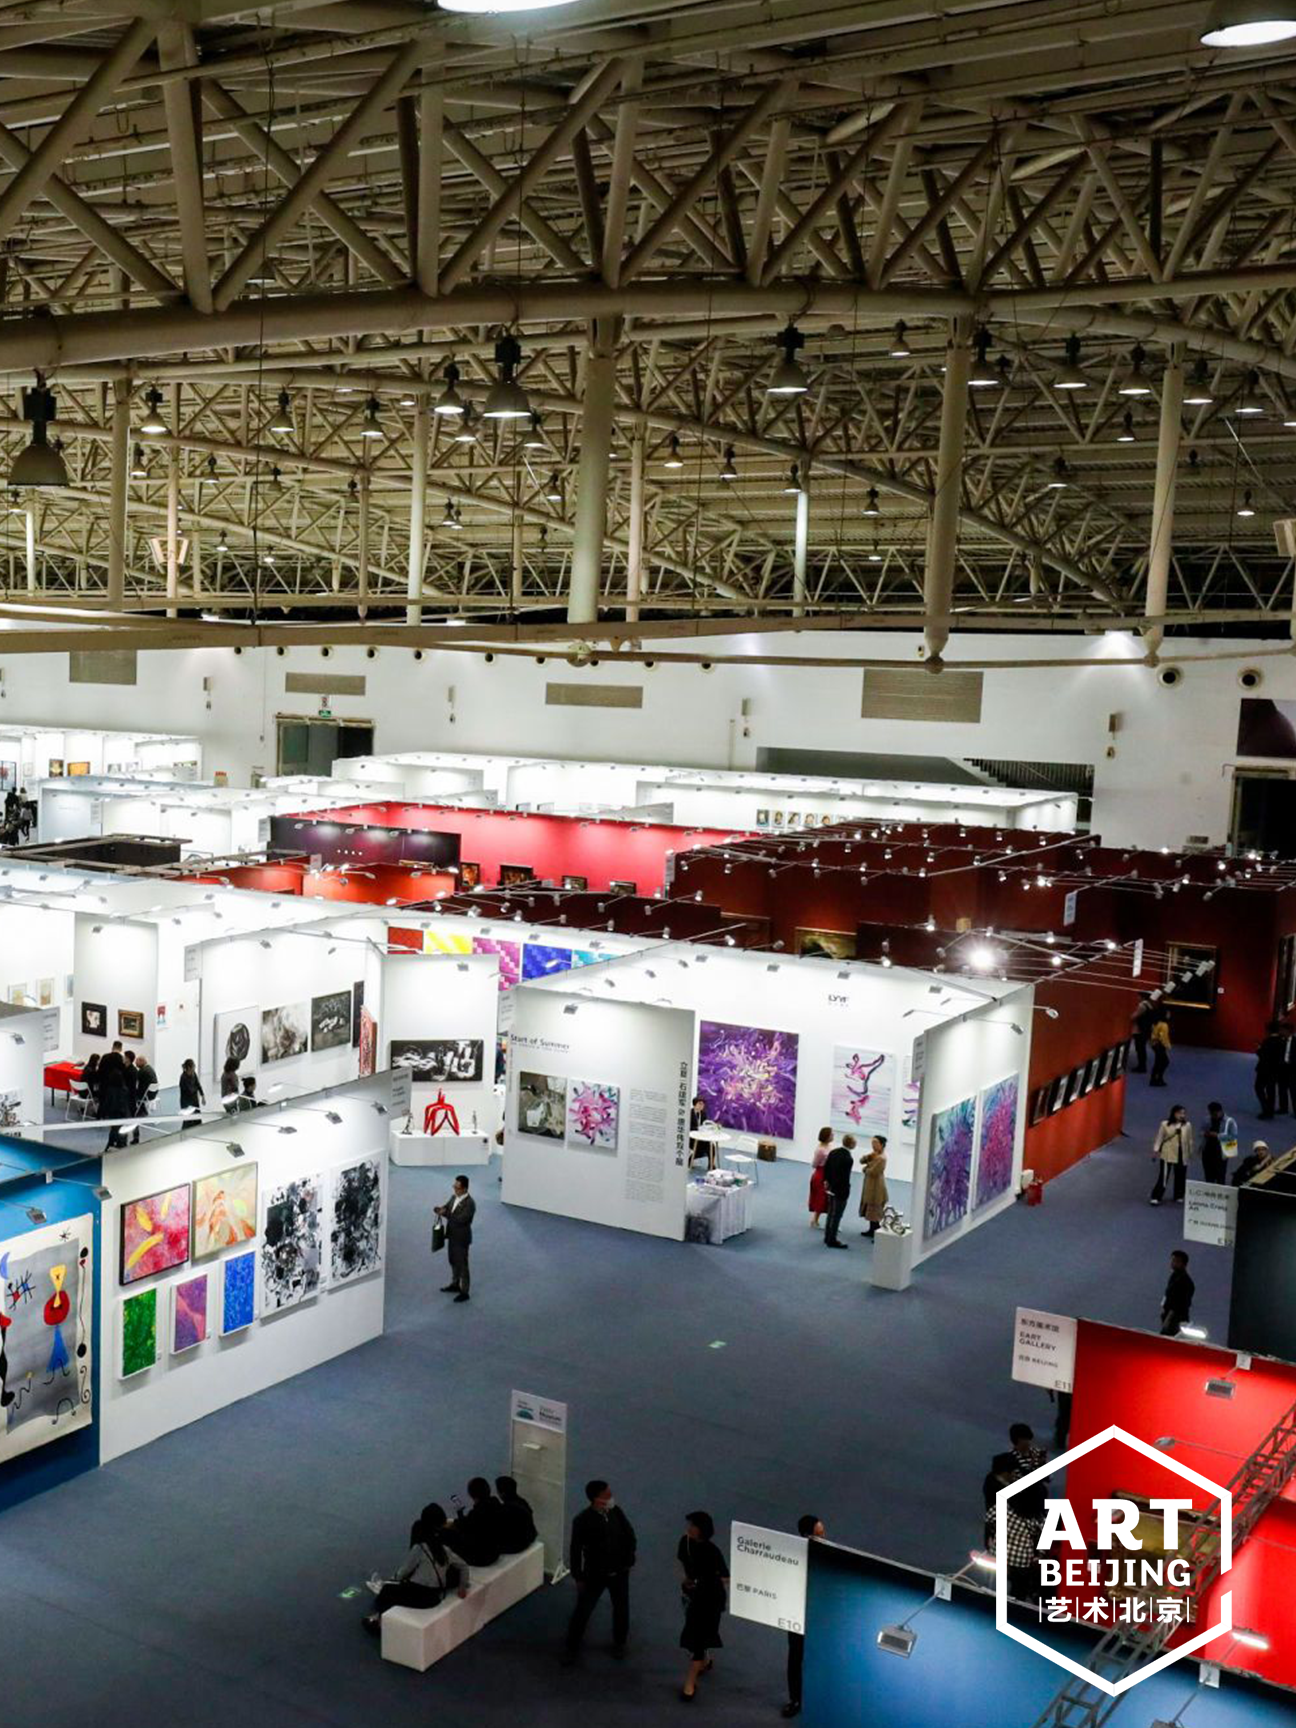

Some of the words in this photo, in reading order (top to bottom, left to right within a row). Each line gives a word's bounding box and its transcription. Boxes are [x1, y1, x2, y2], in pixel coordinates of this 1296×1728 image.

[1019, 1338, 1057, 1352] GALLERY
[1054, 1380, 1072, 1393] E11
[737, 1536, 771, 1551] Galerie
[737, 1544, 800, 1566] Charraudeau
[752, 1588, 777, 1600] PARIS
[778, 1617, 802, 1632] E10
